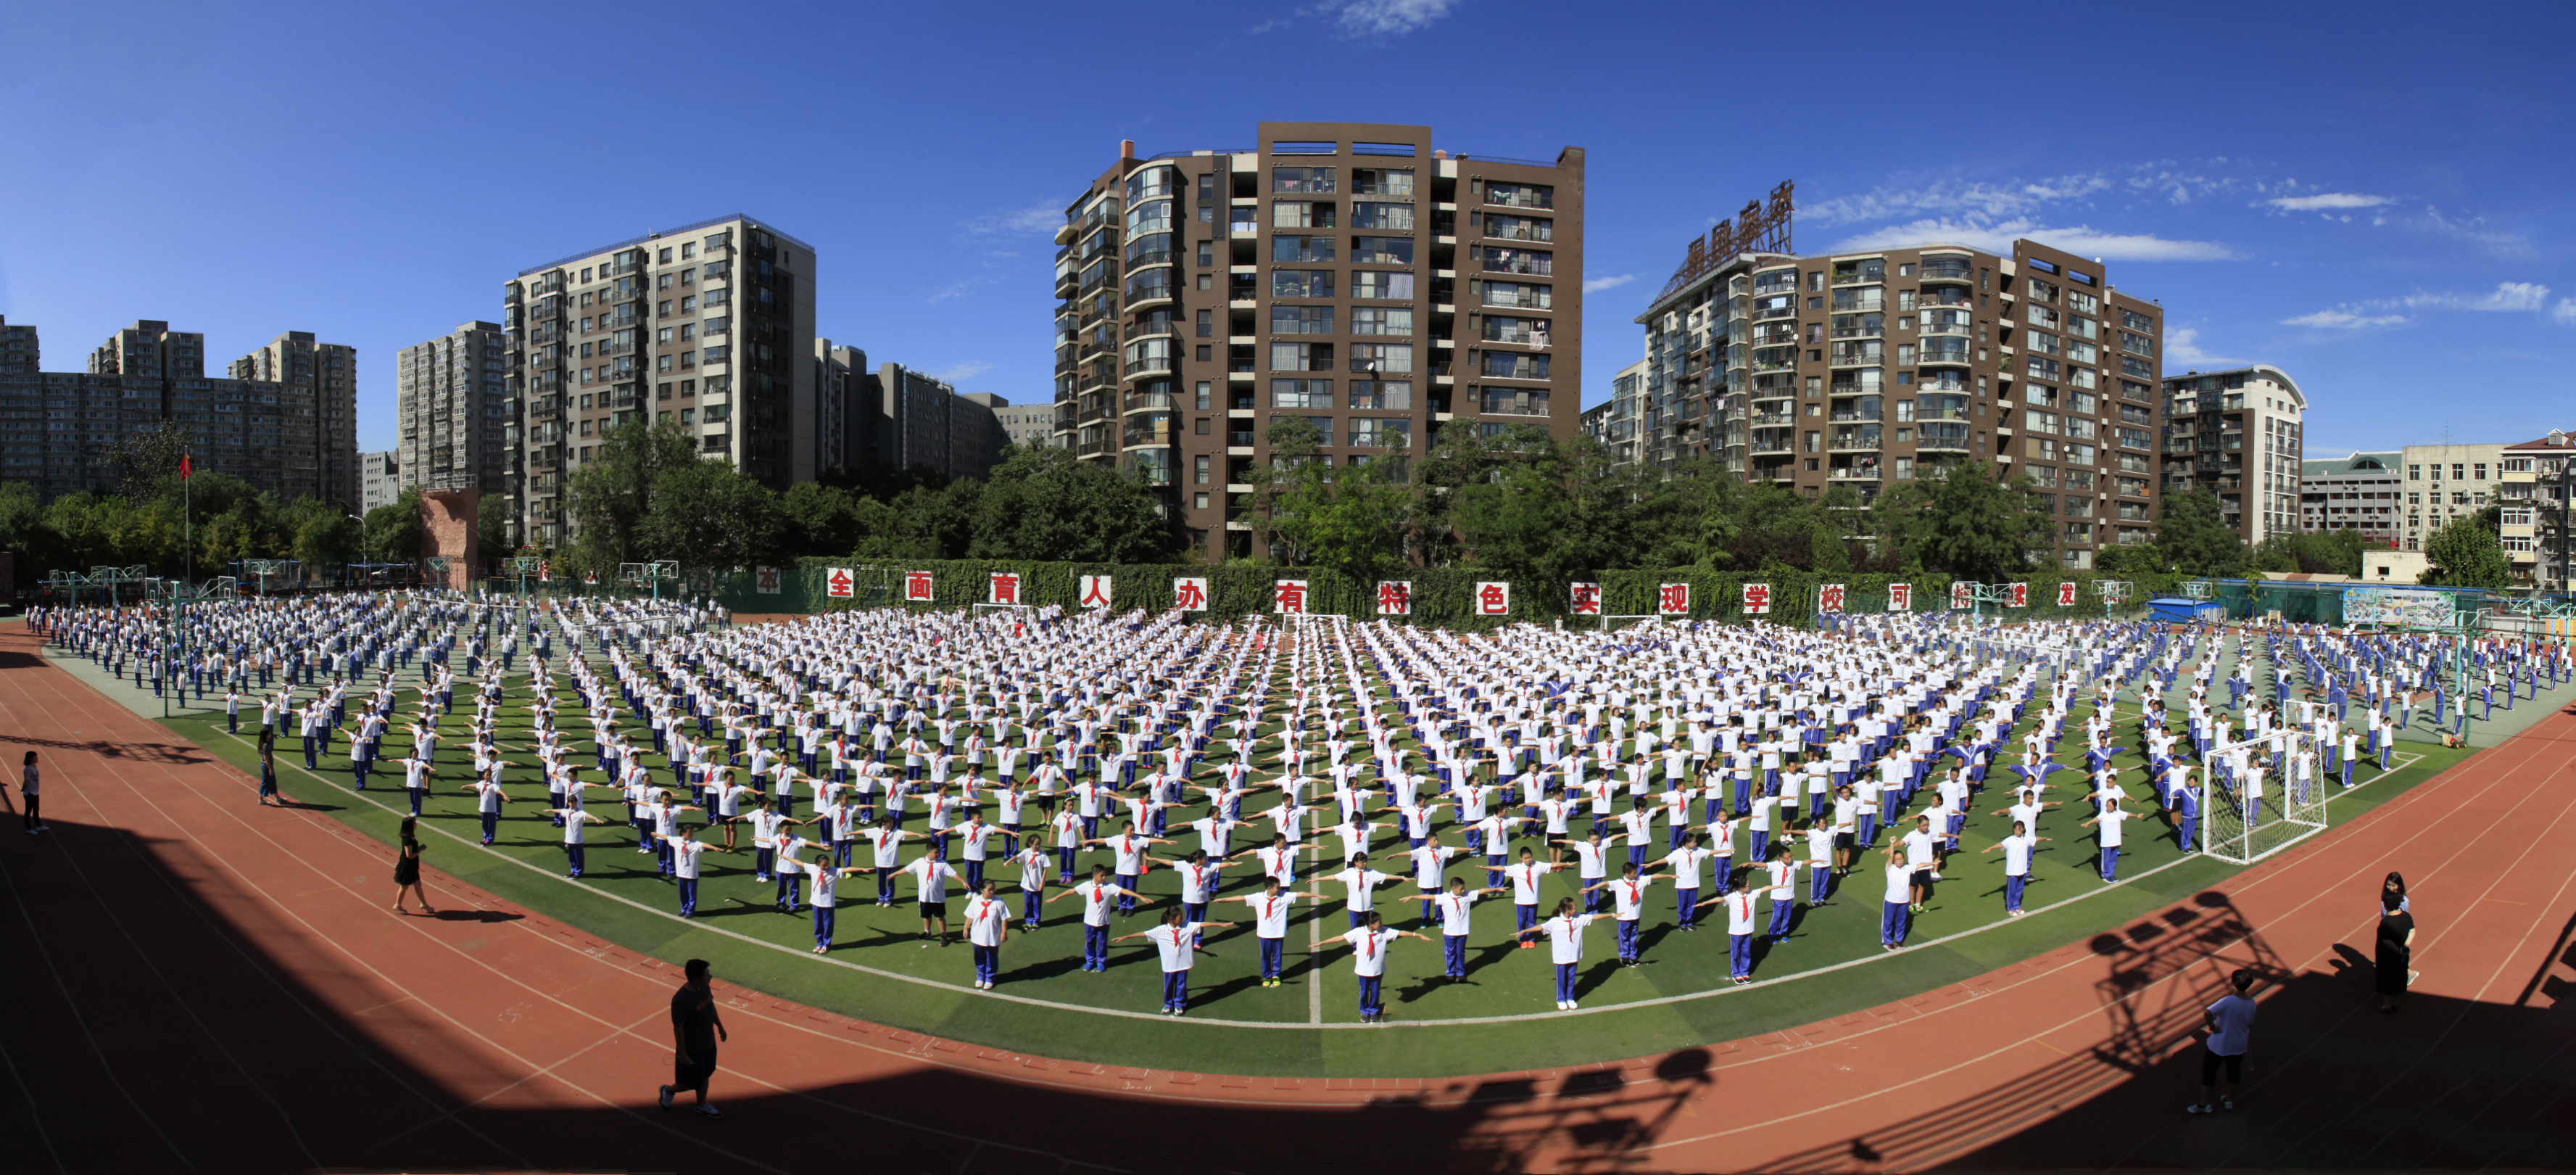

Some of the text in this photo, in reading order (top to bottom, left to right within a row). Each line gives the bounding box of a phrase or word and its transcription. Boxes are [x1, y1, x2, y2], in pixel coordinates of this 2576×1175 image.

[758, 567, 779, 593] 本
[829, 569, 853, 596] 全
[906, 572, 932, 599] 面
[991, 573, 1018, 603] 育
[1082, 577, 1110, 606] 人
[1176, 580, 1205, 610] 办
[1275, 582, 1306, 614] 有
[1378, 582, 1409, 614] 特
[1479, 584, 1507, 614] 色
[1573, 585, 1599, 614] 实
[1661, 585, 1688, 612] 现
[1745, 585, 1768, 613] 学
[1821, 585, 1843, 611] 校
[1891, 585, 1910, 609] 可
[2060, 583, 2074, 605] 发
